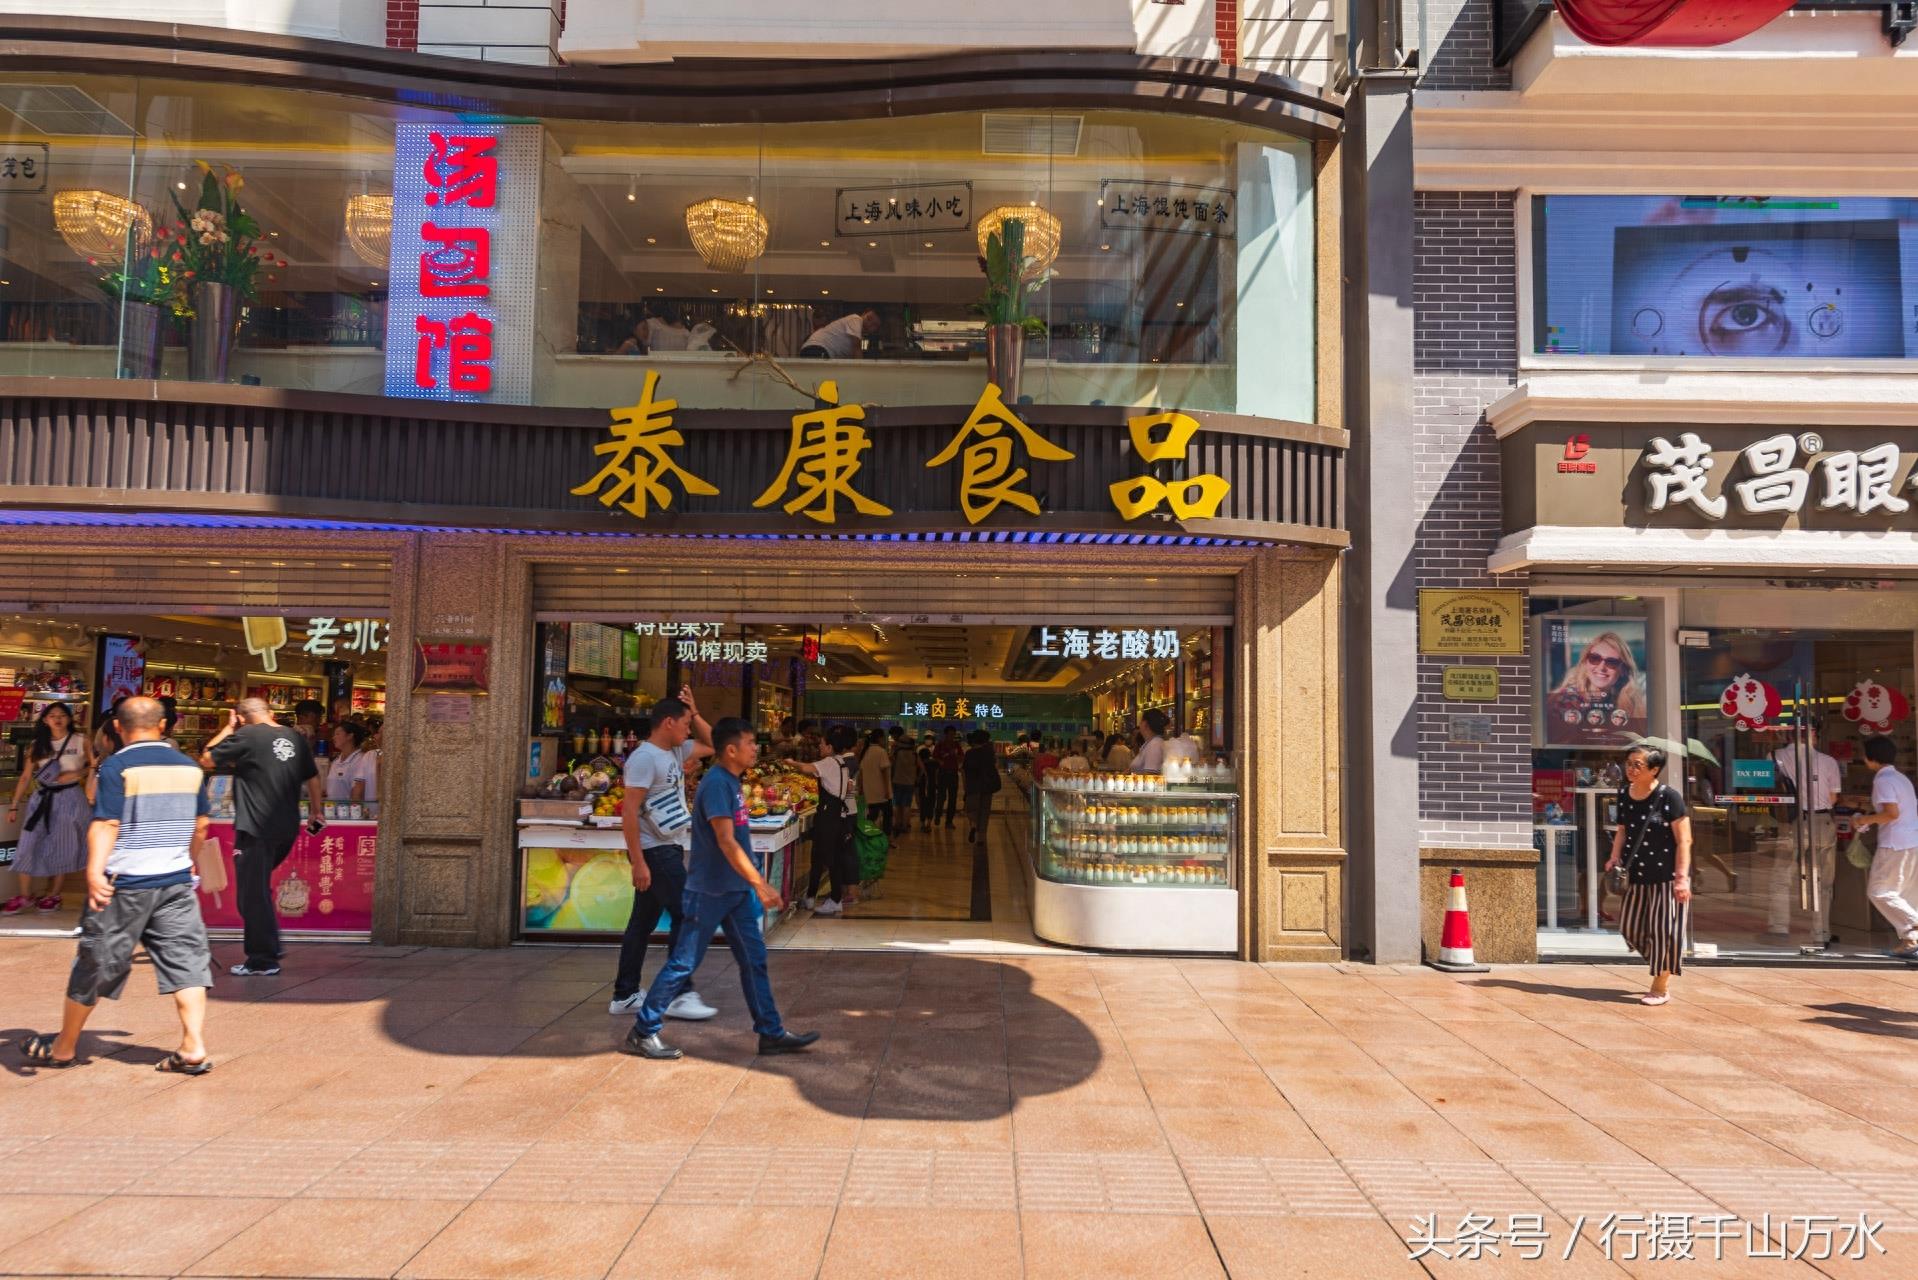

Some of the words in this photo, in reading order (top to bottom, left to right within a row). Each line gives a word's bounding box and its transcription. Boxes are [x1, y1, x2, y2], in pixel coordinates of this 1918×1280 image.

[844, 195, 964, 222] 上海风味小吃
[1110, 194, 1230, 224] 上海馄饨面条
[570, 369, 1231, 525] 泰康食品
[303, 617, 390, 655] 老冰
[1031, 627, 1180, 659] 上海老酸奶
[675, 640, 768, 663] 现榨现卖
[900, 698, 1004, 719] 上海卤菜特色
[1753, 770, 1770, 778] FREE
